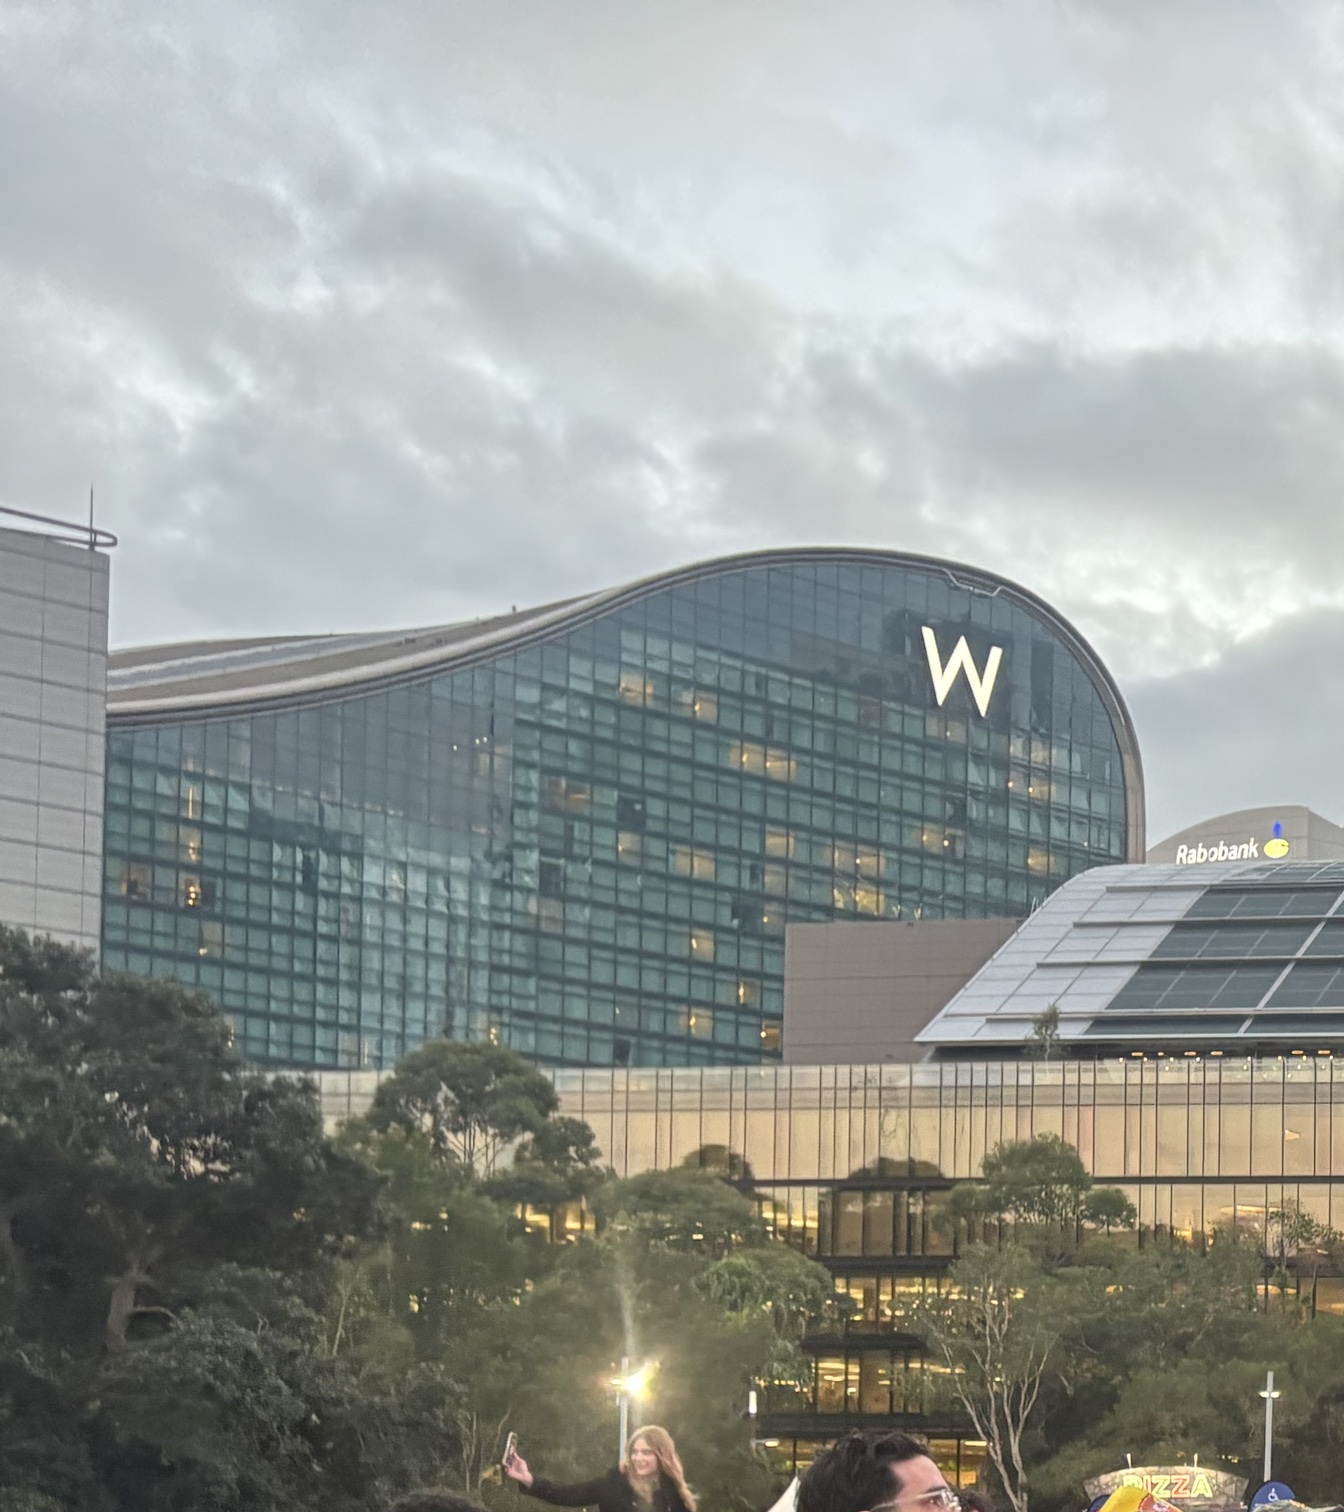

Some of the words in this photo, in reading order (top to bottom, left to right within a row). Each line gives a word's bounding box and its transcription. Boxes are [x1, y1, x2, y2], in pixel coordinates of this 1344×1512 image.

[921, 625, 1003, 718] W
[1175, 837, 1259, 865] Rabobank
[1122, 1474, 1213, 1498] PIZZA
